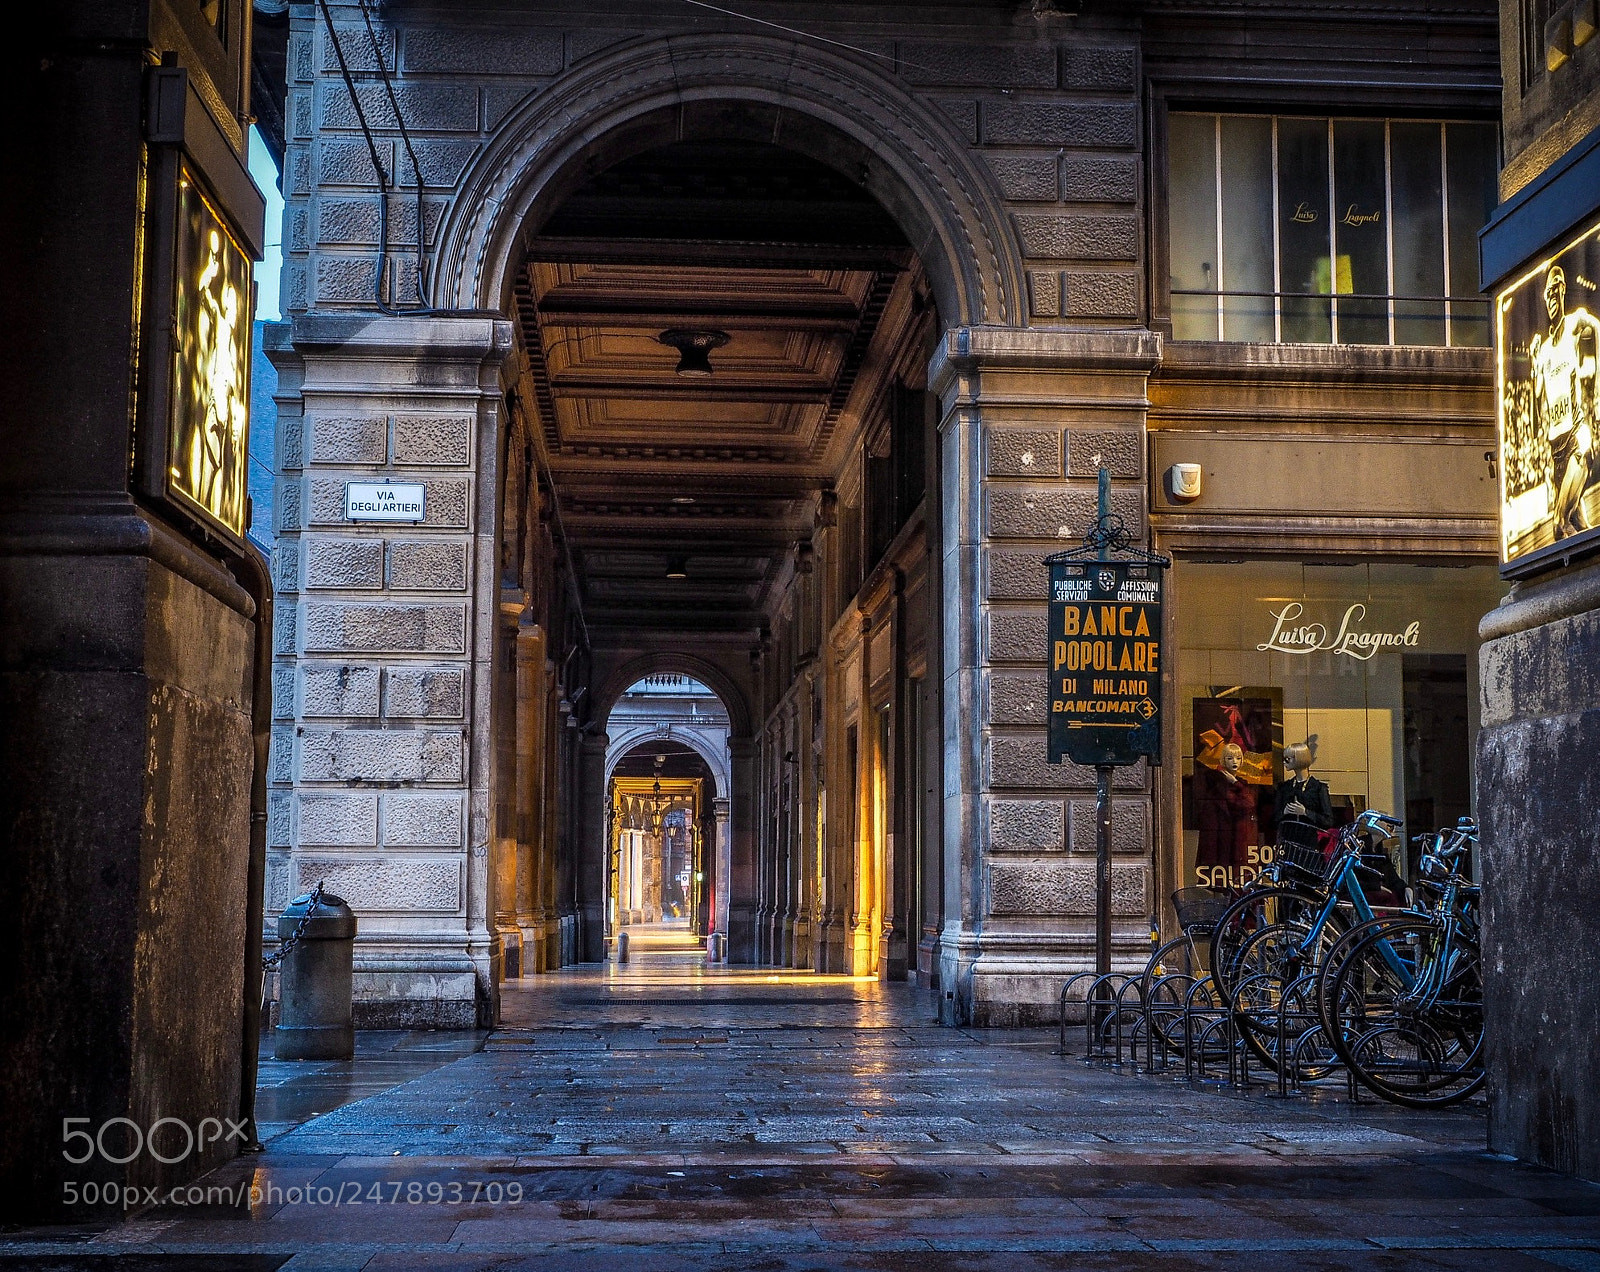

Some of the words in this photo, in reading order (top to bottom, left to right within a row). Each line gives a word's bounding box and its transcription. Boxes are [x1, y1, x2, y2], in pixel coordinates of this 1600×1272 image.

[1290, 202, 1319, 223] Luisa
[1340, 203, 1380, 227] Spagnoli
[377, 491, 395, 501] VIA
[351, 502, 381, 512] DEGLI
[382, 502, 421, 513] ARTIERI
[1054, 580, 1093, 591] PUBBLICHE
[1120, 581, 1159, 592] AFFISSIONI
[1056, 590, 1088, 601] SERVIZIO
[1117, 591, 1155, 602] COMUNALE
[1064, 605, 1150, 637] BANCA
[1256, 602, 1327, 654] Luisa
[1326, 603, 1420, 661] Spagnoli
[1054, 640, 1159, 673] POPOLARE
[1062, 678, 1077, 694] DI
[1093, 679, 1148, 696] MILANO
[1052, 700, 1138, 713] BANCOMAT
